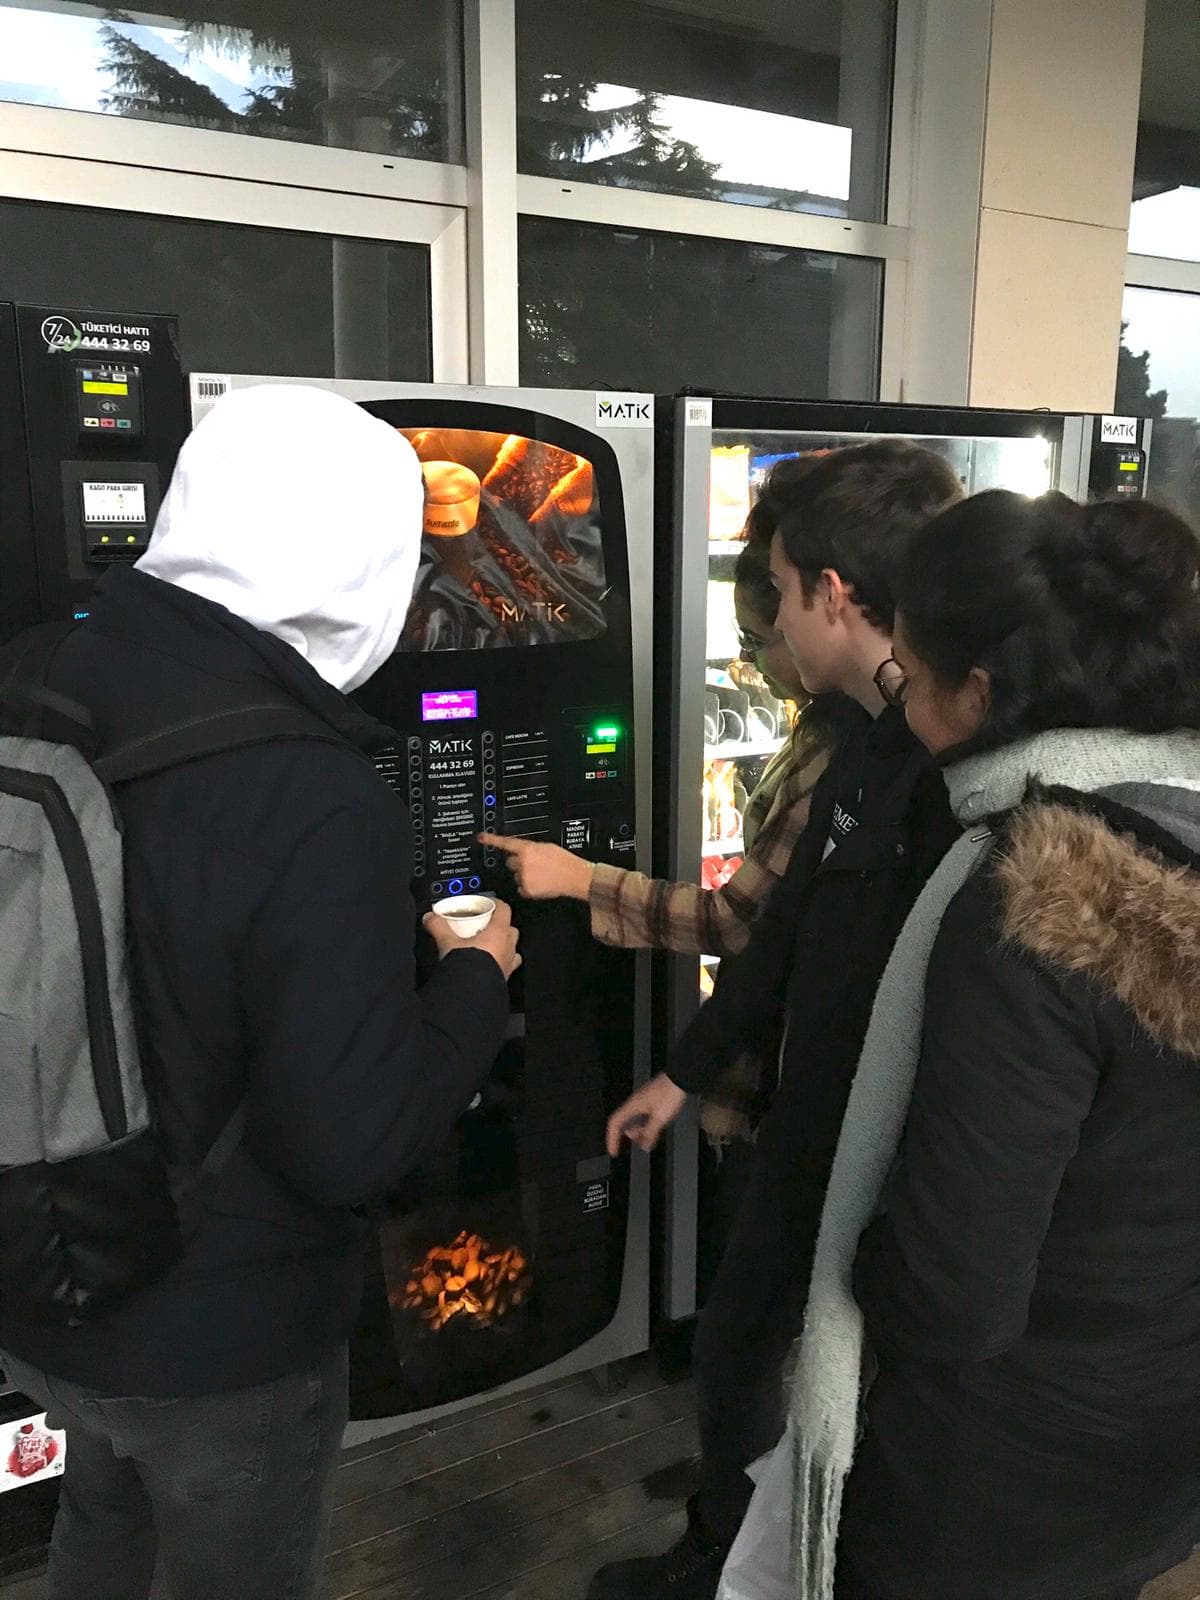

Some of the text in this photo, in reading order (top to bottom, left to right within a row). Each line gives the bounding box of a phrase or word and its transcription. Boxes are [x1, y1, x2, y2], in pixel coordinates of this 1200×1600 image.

[81, 336, 151, 352] 444 32 69
[430, 759, 475, 770] 444 32 69
